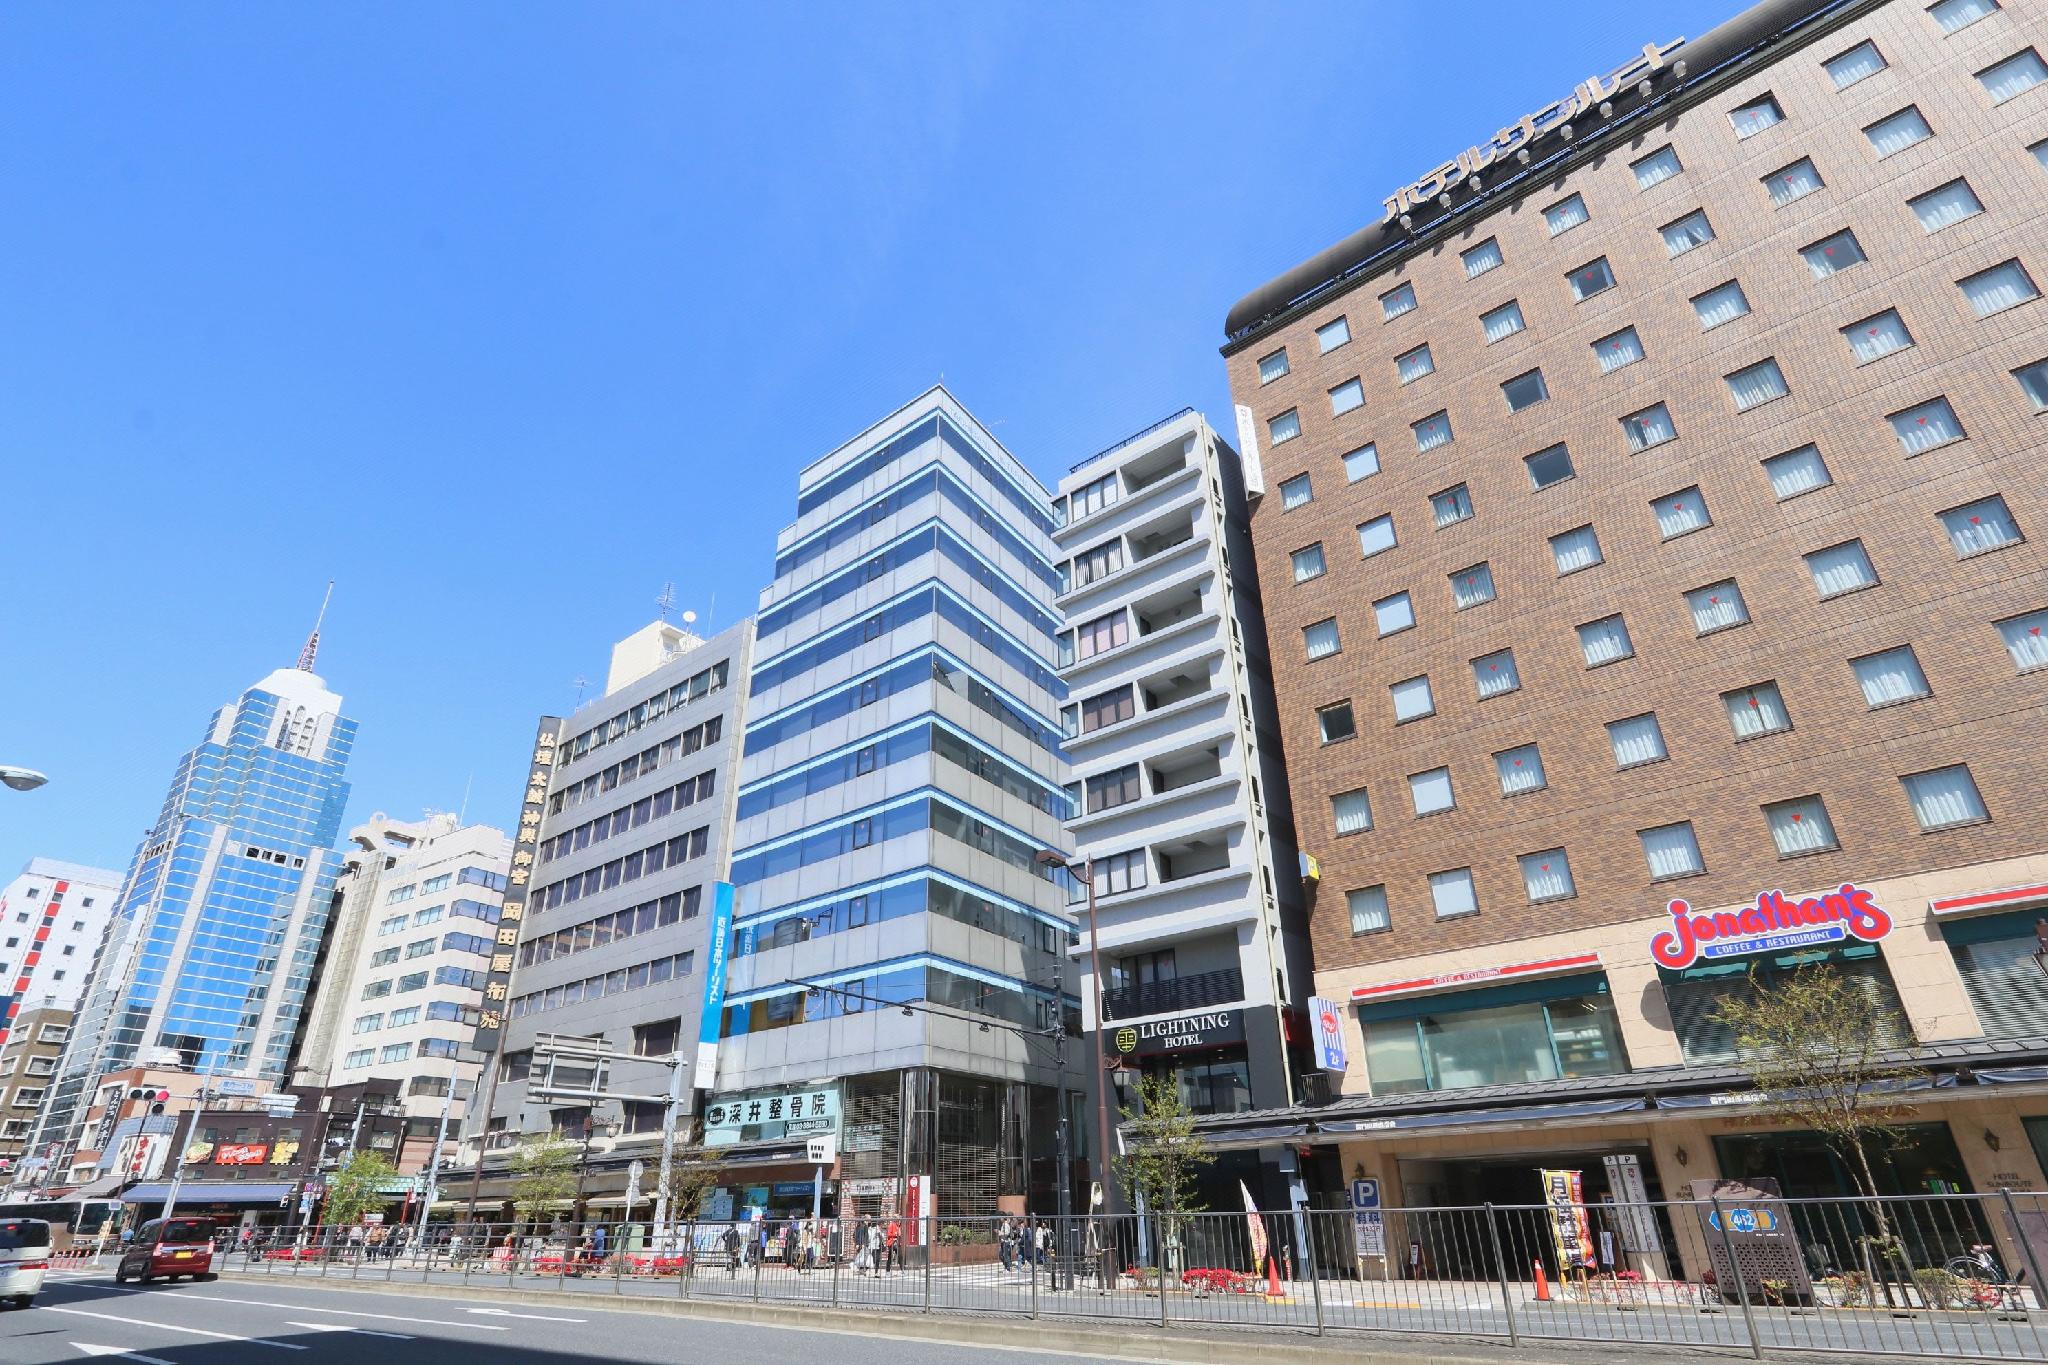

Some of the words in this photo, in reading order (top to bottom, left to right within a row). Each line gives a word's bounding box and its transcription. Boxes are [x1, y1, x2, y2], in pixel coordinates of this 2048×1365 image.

[1383, 36, 1685, 223] ホテルサンルート
[1715, 941, 1752, 955] COFFEE
[1755, 940, 1764, 950] &
[1766, 931, 1832, 948] RESTAURANT
[1140, 1012, 1230, 1039] LIGHTNING
[1164, 1033, 1203, 1049] HOTEL
[728, 1092, 826, 1124] 深井整骨院
[1357, 1182, 1375, 1205] P
